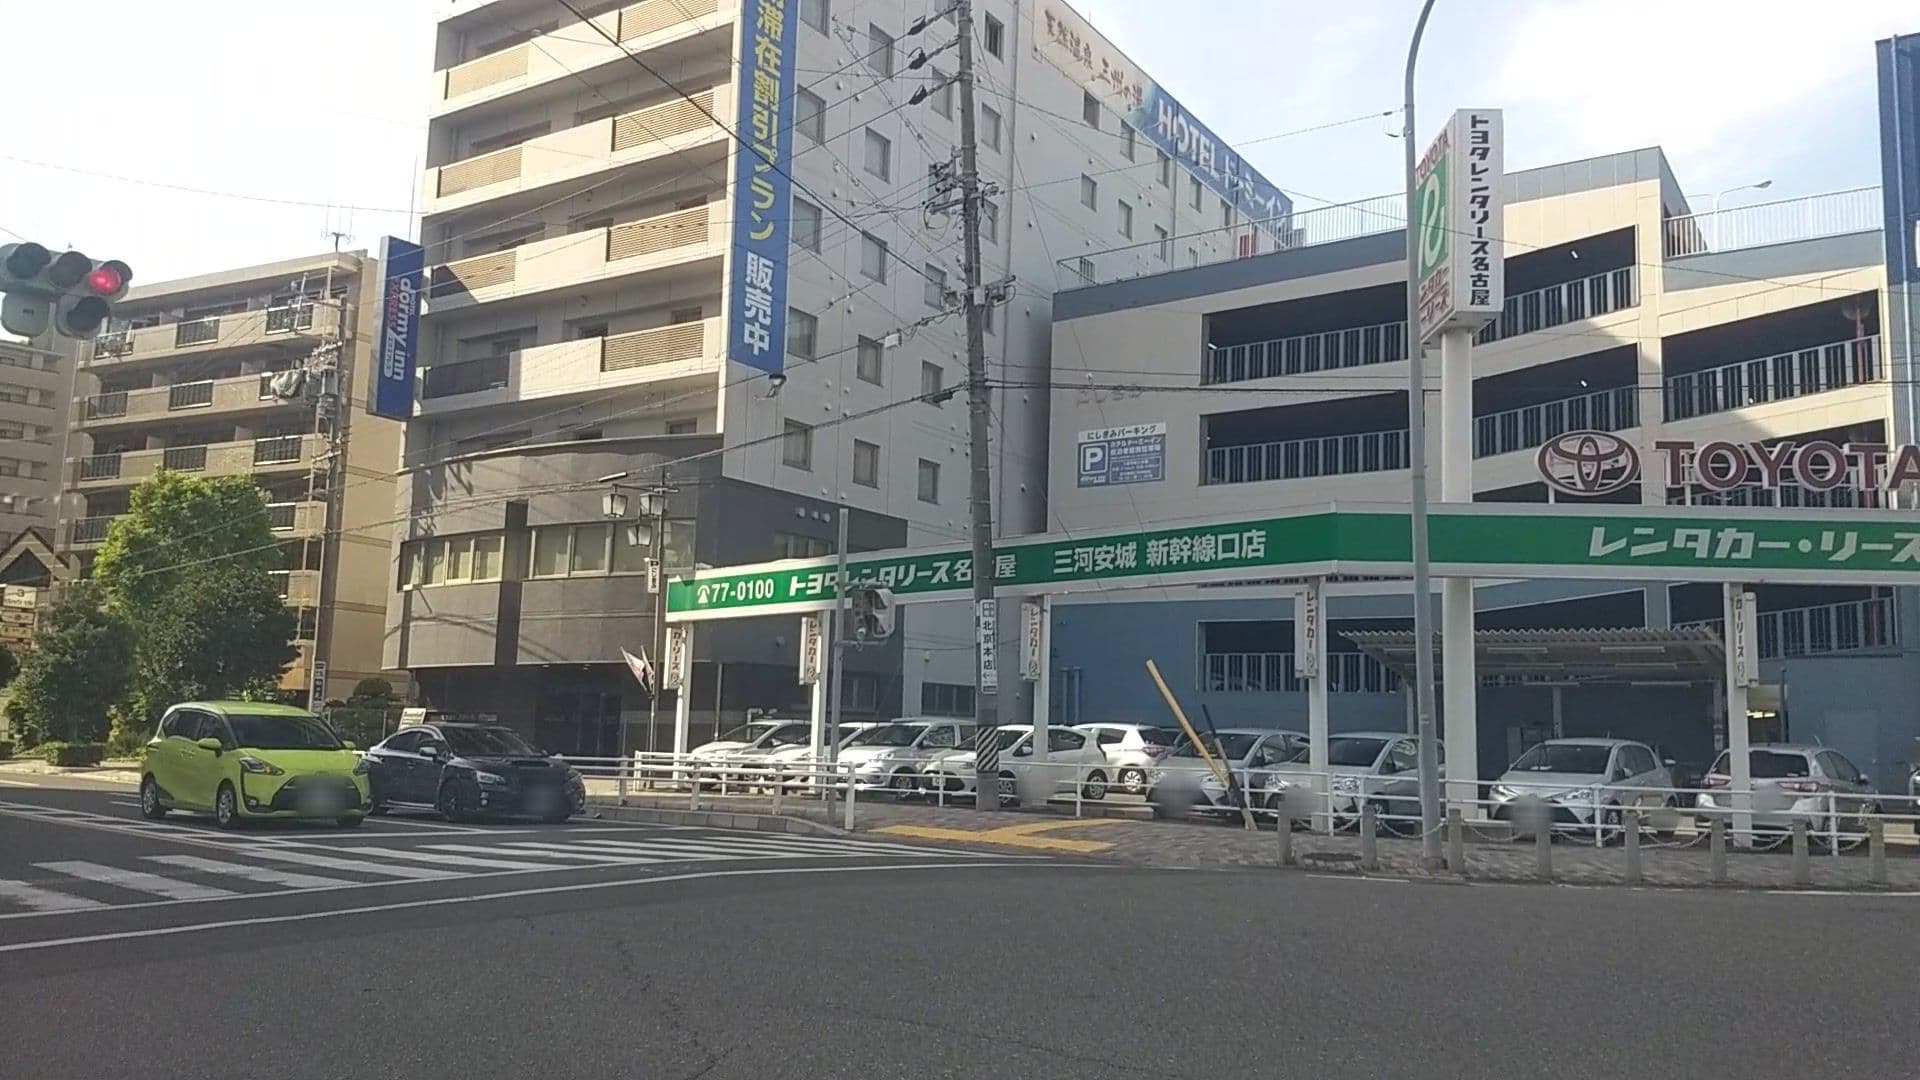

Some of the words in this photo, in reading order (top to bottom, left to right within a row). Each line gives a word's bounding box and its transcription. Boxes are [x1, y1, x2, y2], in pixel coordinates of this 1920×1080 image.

[751, 0, 785, 241] 滞在割引プラン
[1158, 97, 1219, 179] HOTEL
[1469, 115, 1491, 306] トヨタレンタリース名古屋
[394, 278, 416, 347] dormy
[743, 250, 774, 356] 販売中
[393, 350, 409, 381] inn
[1085, 447, 1103, 470] P
[1655, 440, 1920, 491] TOYOTA
[711, 579, 774, 603] 77-0100
[789, 554, 1016, 597] トヨタレンタリース名屋
[1053, 541, 1137, 575] 三河安城
[1146, 530, 1266, 567] 新幹線口店
[1589, 526, 1920, 563] レンタカー・リース
[808, 620, 817, 663] レンタカー
[1030, 608, 1038, 657] レンタカー
[1306, 591, 1315, 649] レンタカー
